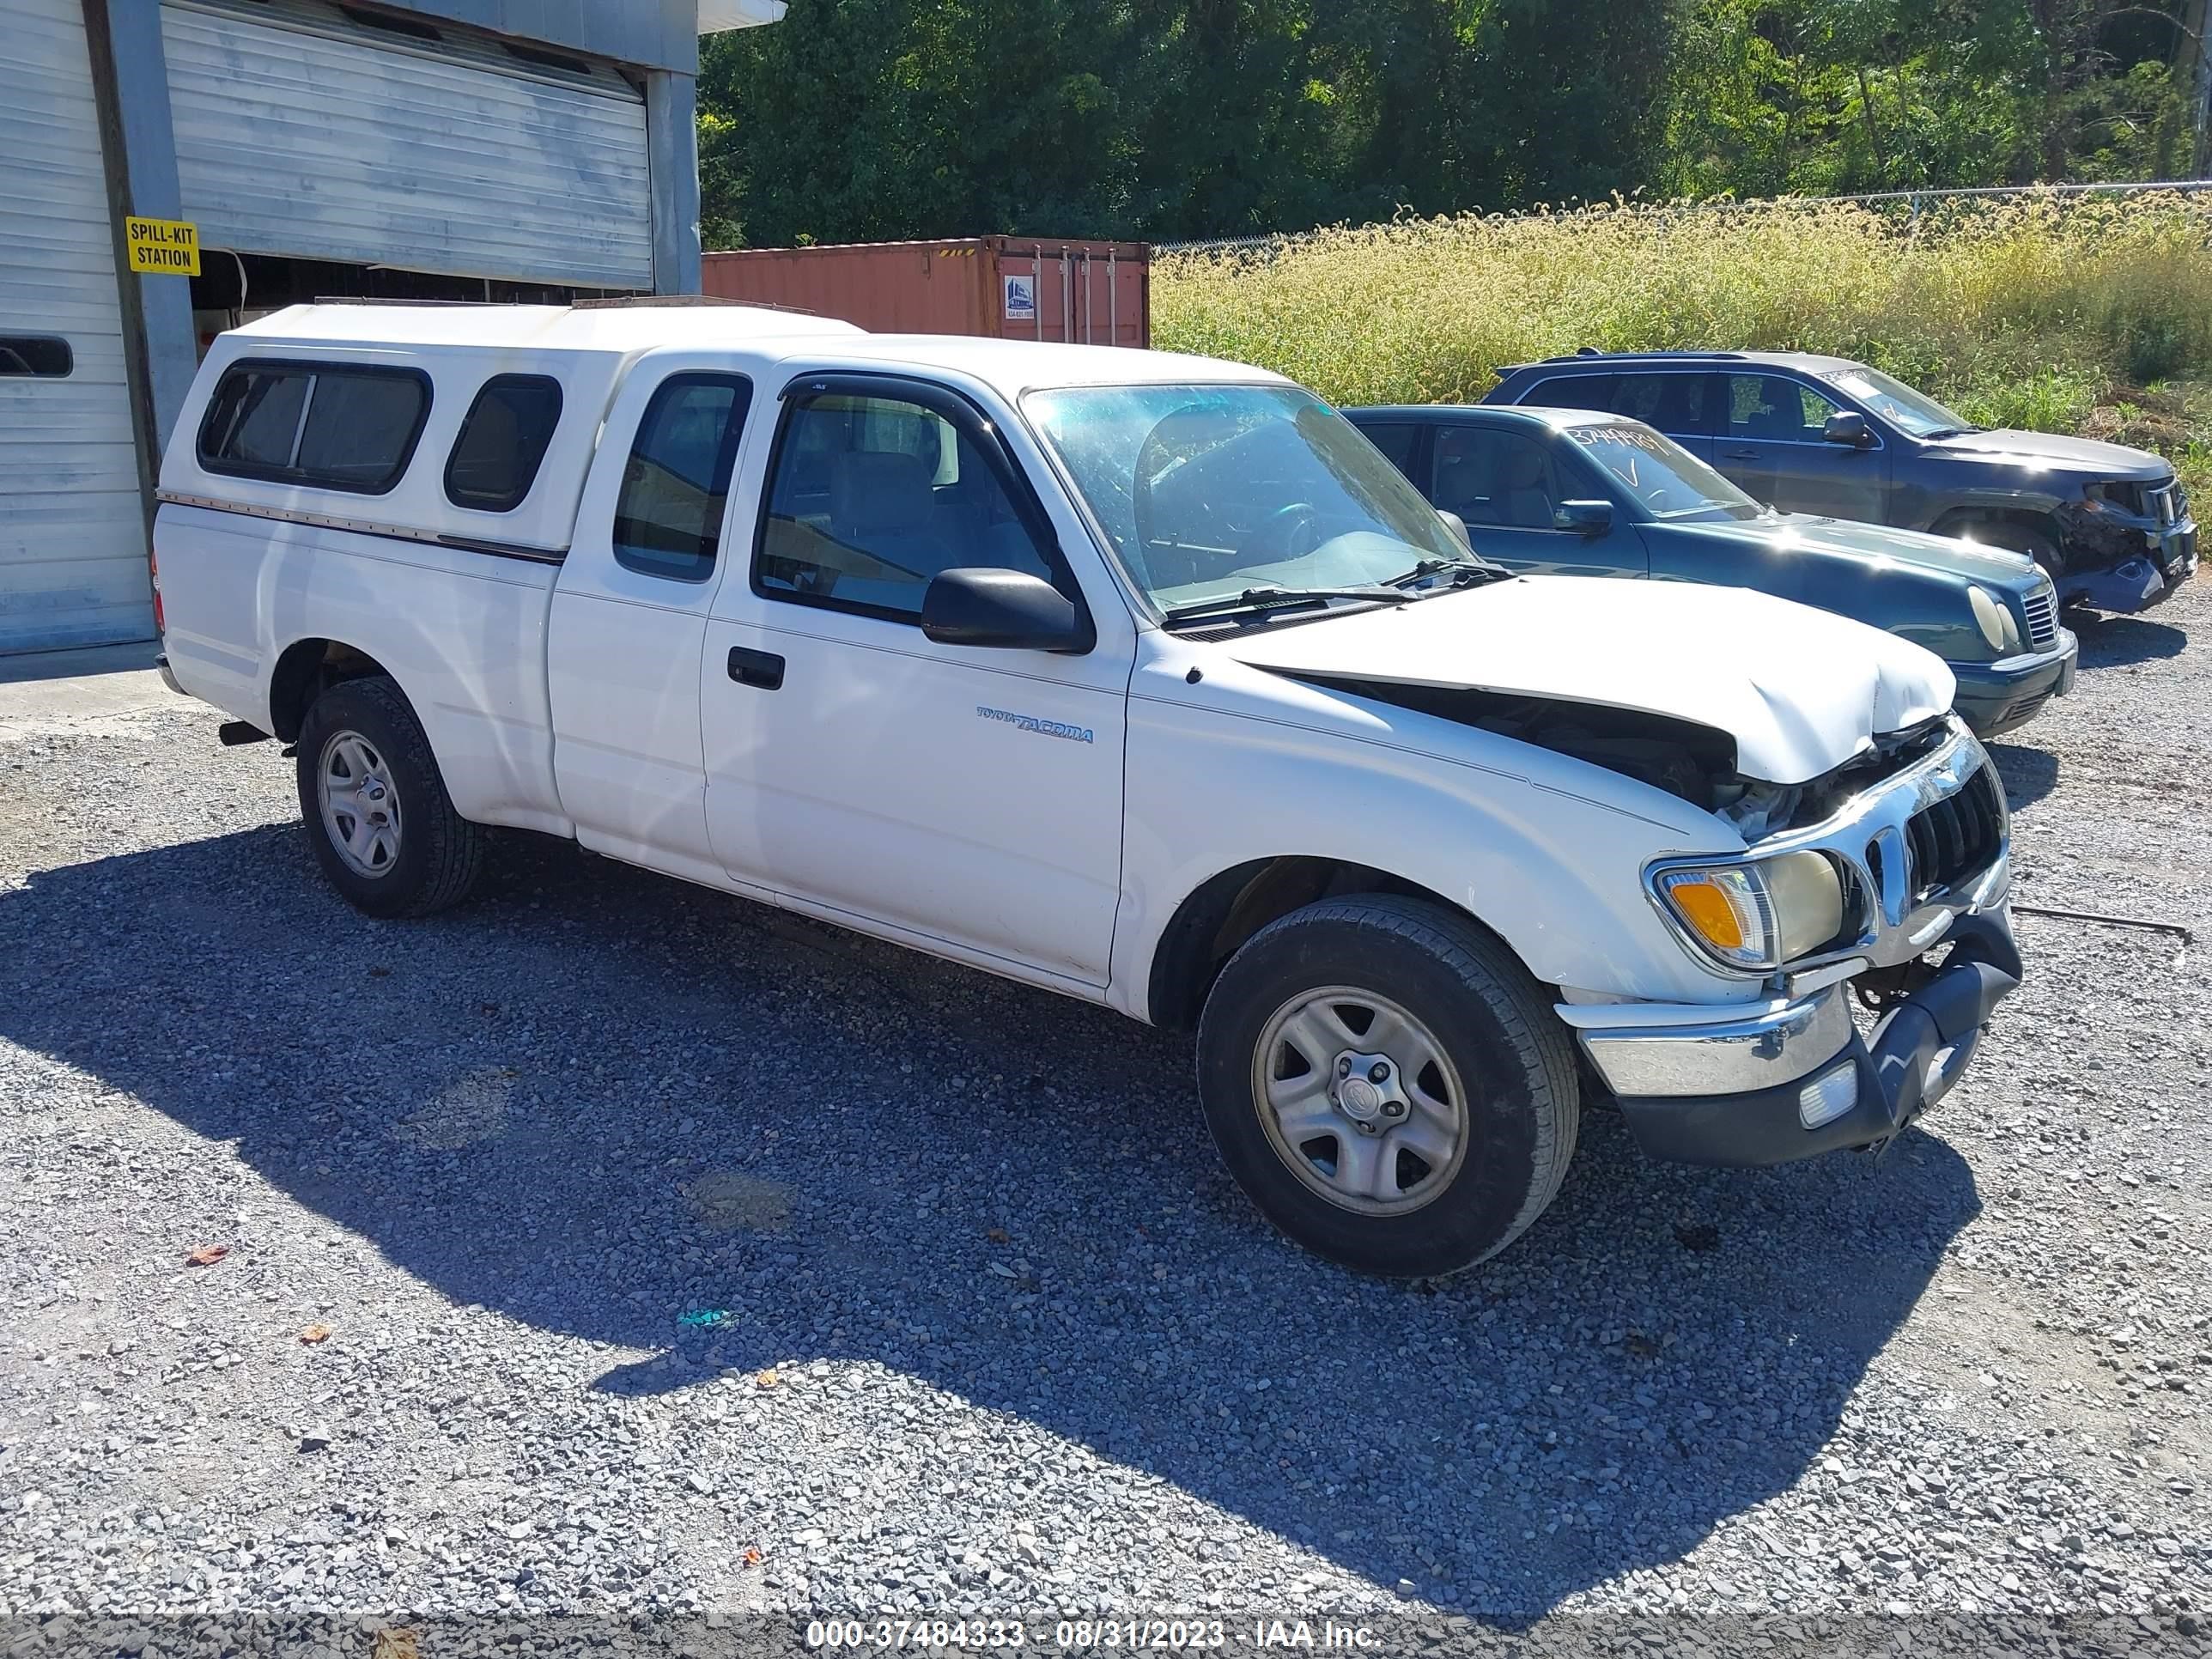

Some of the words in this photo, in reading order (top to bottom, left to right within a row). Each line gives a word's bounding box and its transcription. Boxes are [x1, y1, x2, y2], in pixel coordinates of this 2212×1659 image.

[131, 223, 192, 244] SPILL-KIT
[137, 246, 191, 267] STATION
[976, 707, 1015, 722] TOYOTA
[1015, 715, 1093, 744] TACOMA
